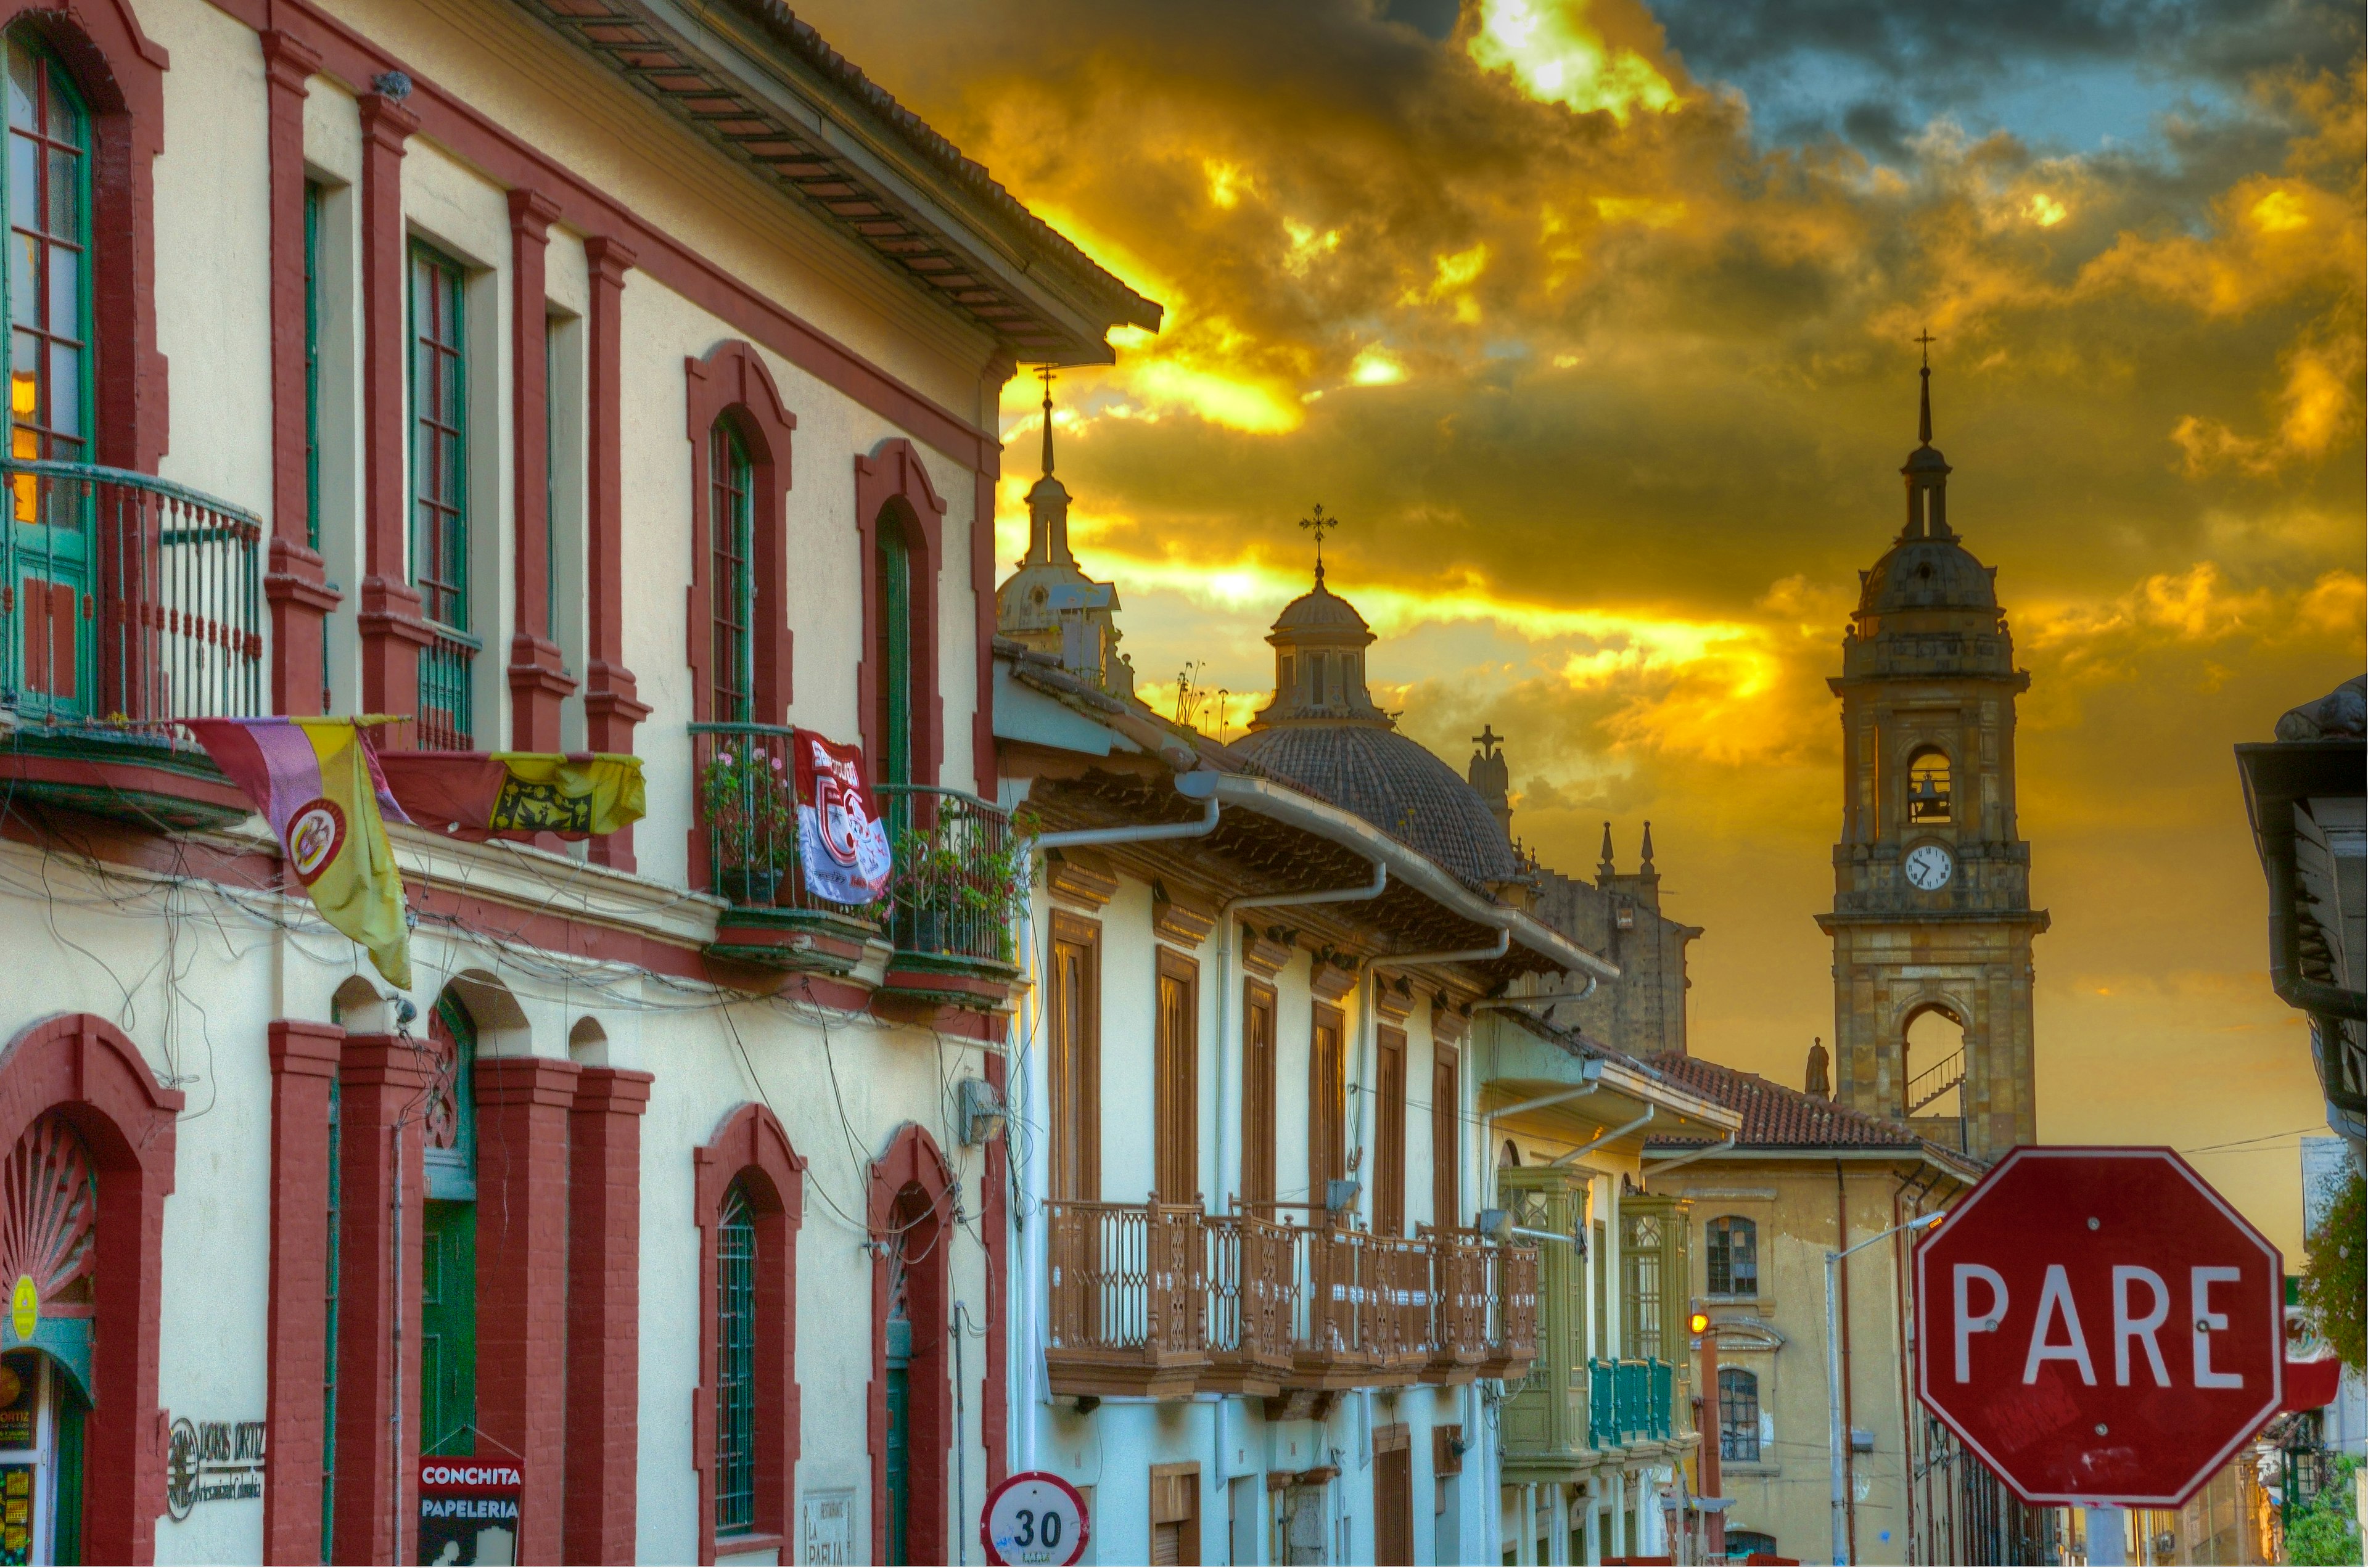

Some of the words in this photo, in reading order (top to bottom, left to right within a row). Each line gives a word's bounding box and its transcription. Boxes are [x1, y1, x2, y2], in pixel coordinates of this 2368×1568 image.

[1954, 1263, 2243, 1389] PARE
[234, 1421, 265, 1461] ORTIZ
[422, 1466, 521, 1485] CONCHITA
[422, 1499, 518, 1518] PAPELERIA
[808, 1521, 817, 1541] LA
[1014, 1509, 1061, 1548] 30
